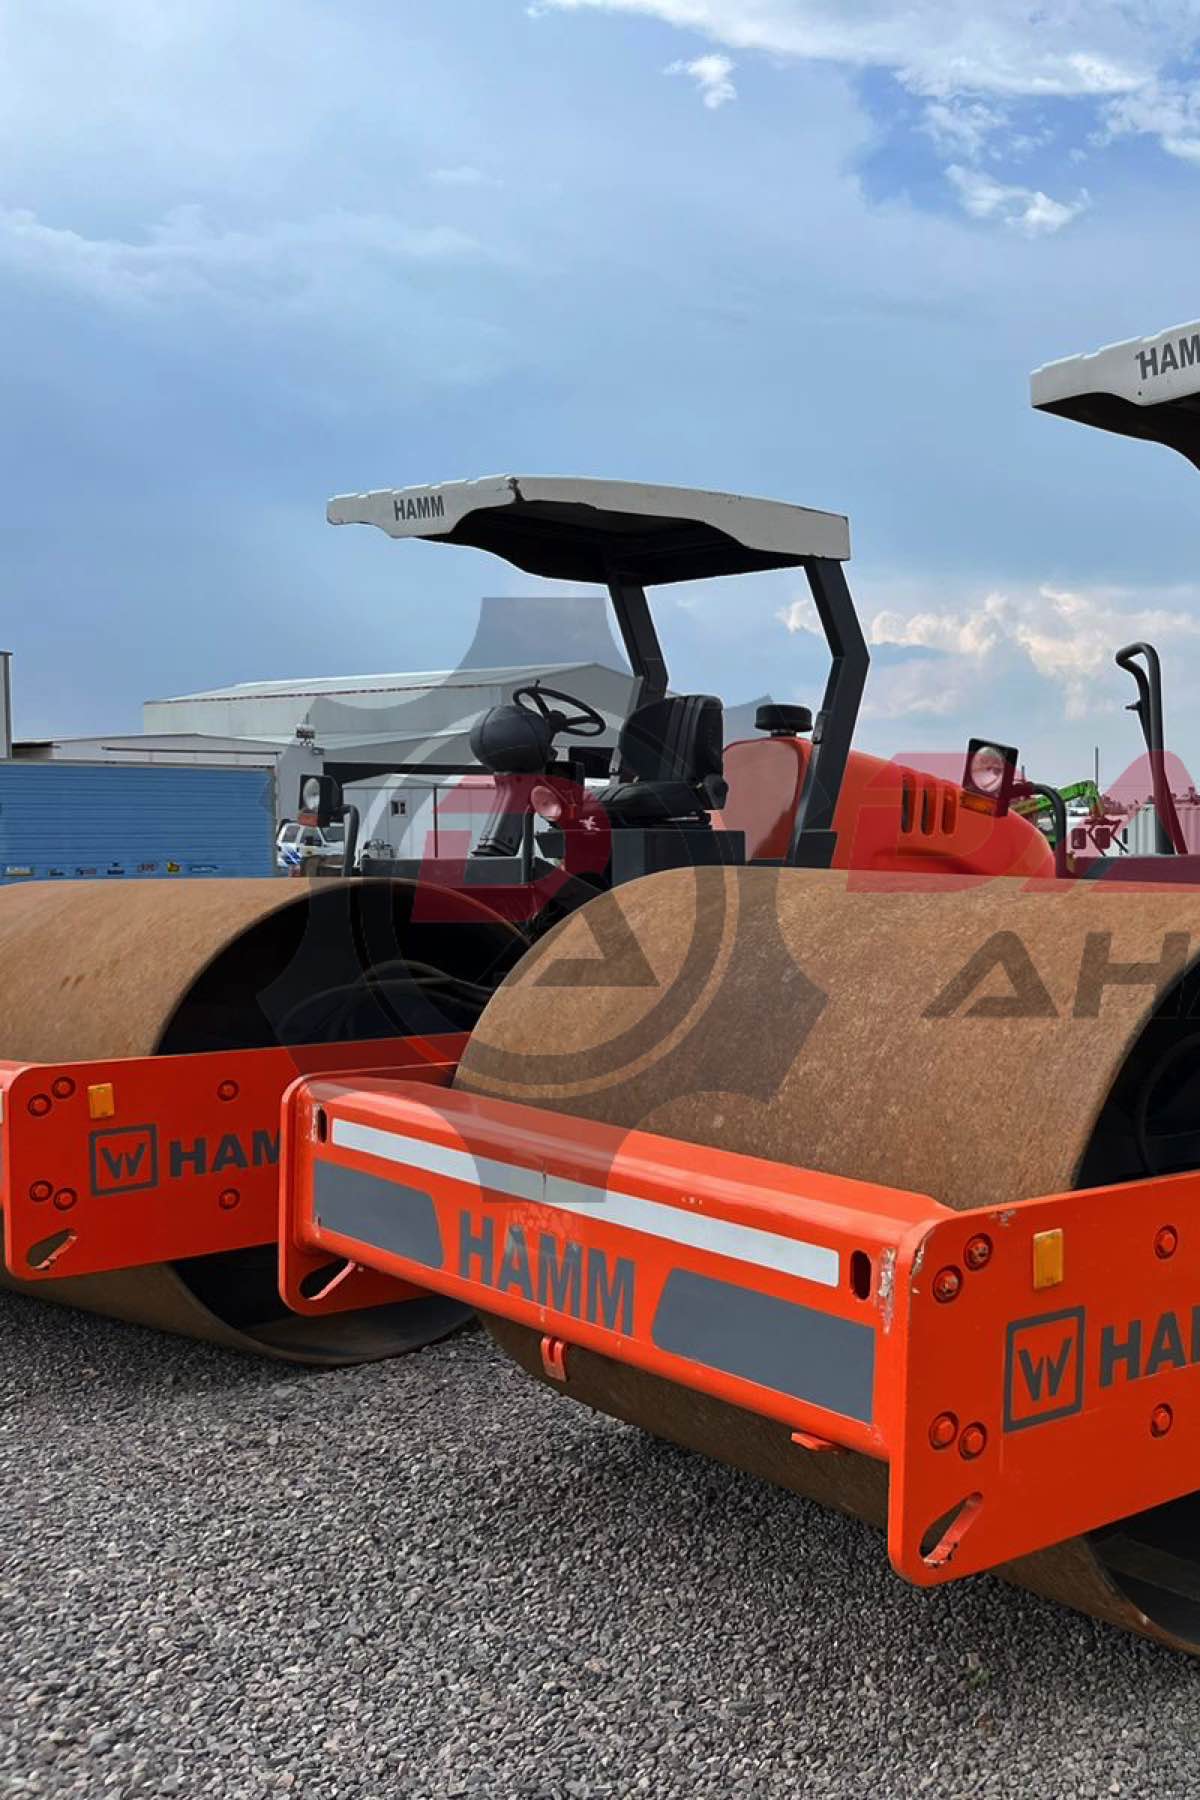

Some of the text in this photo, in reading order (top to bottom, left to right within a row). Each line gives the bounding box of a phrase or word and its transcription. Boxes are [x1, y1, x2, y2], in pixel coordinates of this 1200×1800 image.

[393, 495, 445, 521] HAMM
[169, 1129, 281, 1178] HAM
[459, 1209, 636, 1337] HAMM
